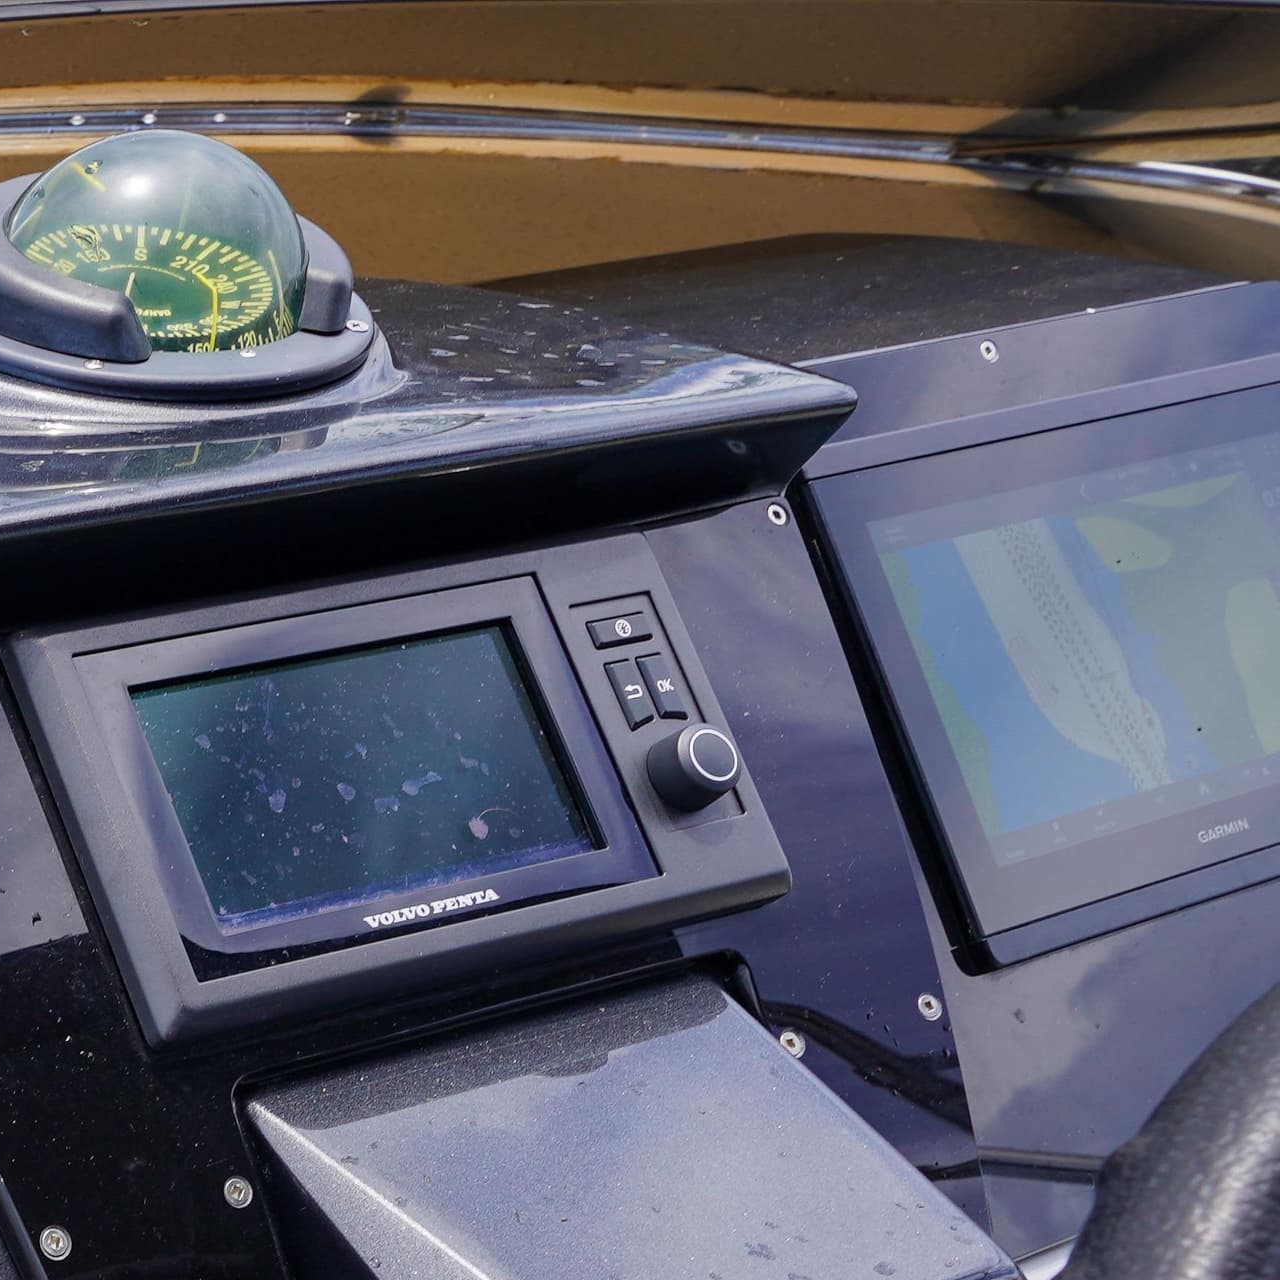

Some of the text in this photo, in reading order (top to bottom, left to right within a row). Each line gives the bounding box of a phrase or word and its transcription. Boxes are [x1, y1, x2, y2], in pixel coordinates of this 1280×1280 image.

[134, 247, 147, 261] S
[170, 255, 210, 275] 210
[656, 678, 675, 693] OK
[1198, 817, 1249, 843] GARMIN
[363, 888, 500, 928] VOLVO PENTA
